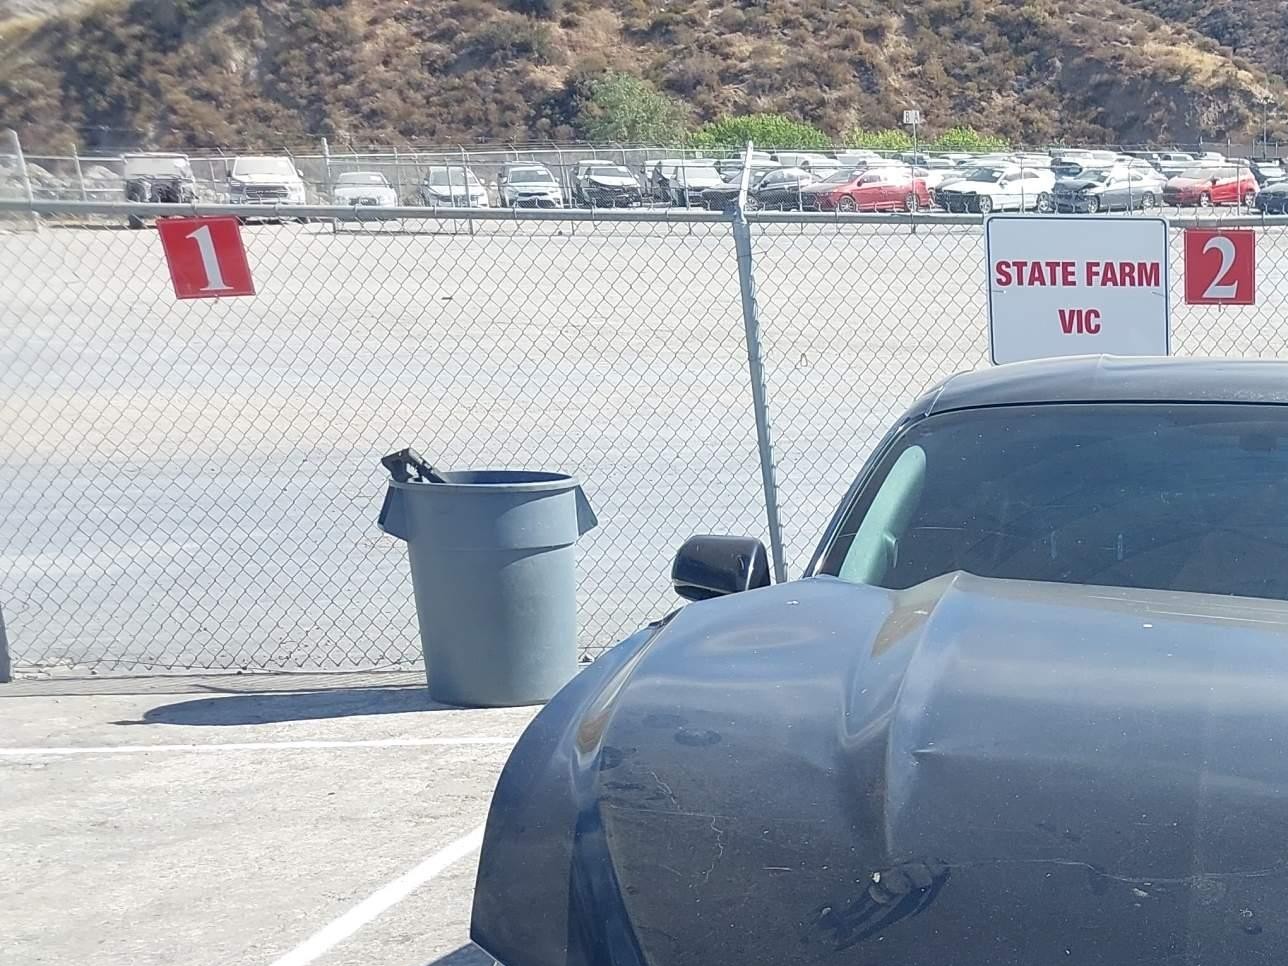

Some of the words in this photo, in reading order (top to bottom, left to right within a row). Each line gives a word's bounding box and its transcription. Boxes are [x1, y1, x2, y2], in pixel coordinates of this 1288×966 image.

[185, 225, 234, 291] 1
[996, 260, 1077, 287] STATE
[1086, 261, 1160, 287] FARM
[1202, 235, 1239, 299] 2
[1058, 309, 1101, 334] VIC
